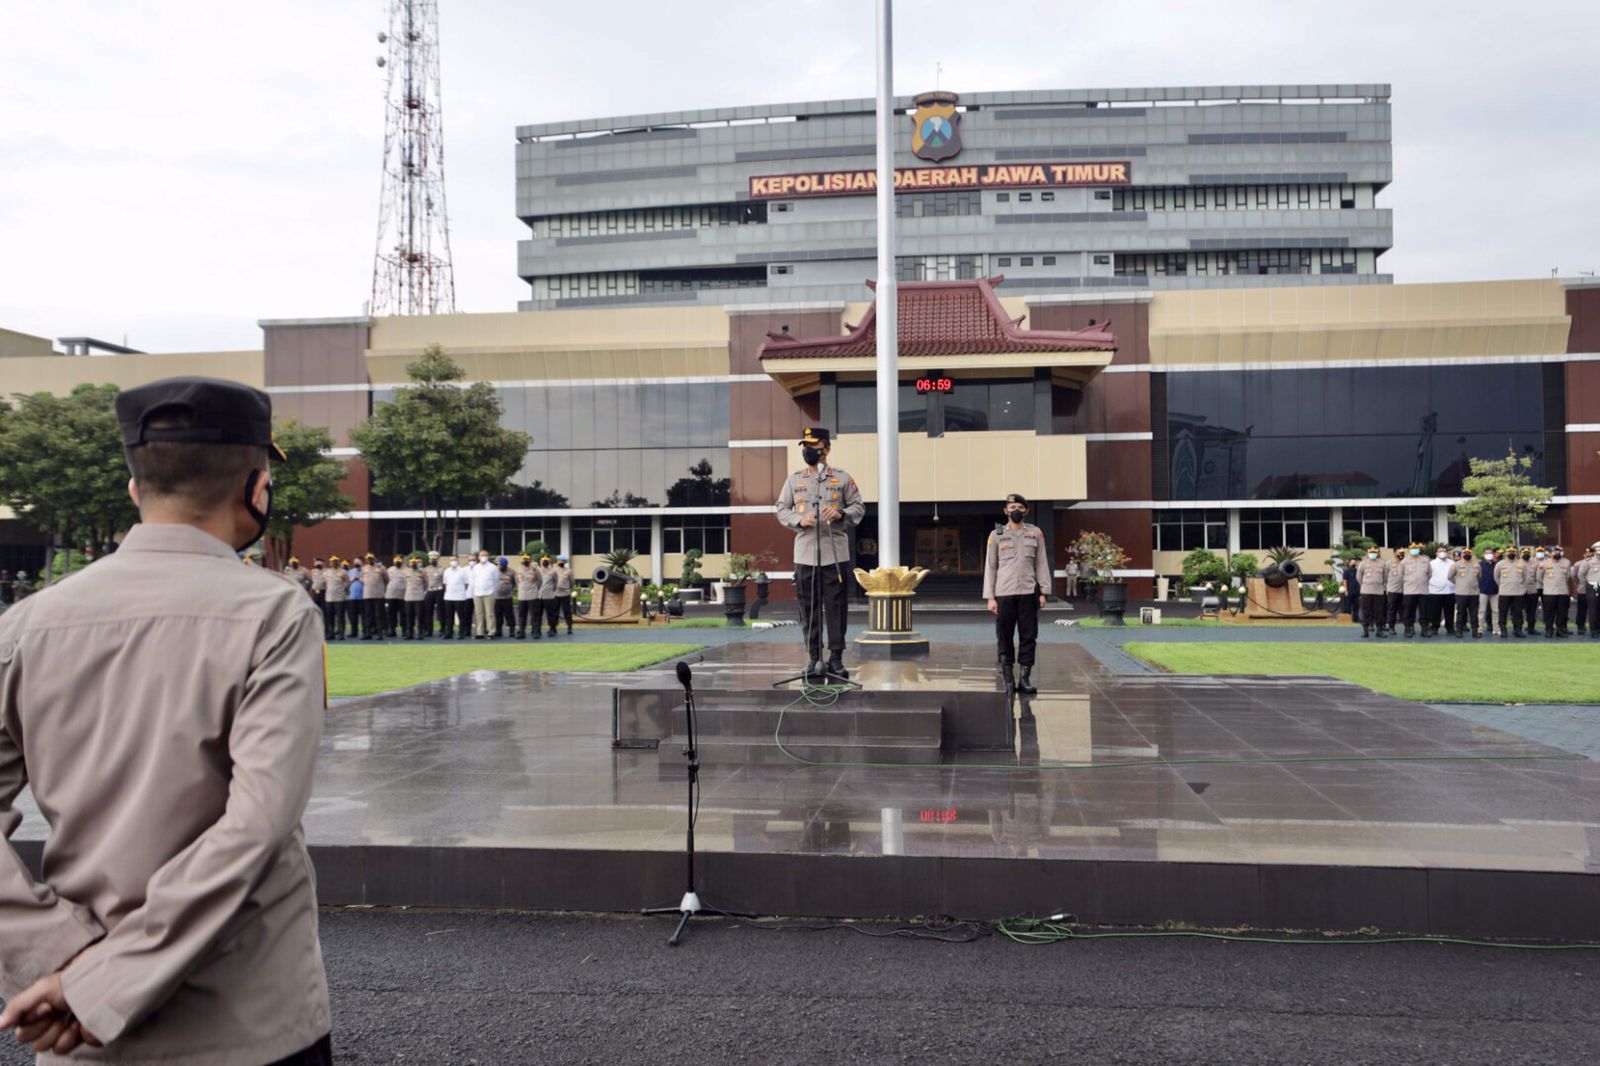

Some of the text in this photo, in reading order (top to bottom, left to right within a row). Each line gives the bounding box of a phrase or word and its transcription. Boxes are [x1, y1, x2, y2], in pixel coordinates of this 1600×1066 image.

[980, 165, 1048, 185] JAWA
[1050, 164, 1129, 185] TIMUR
[916, 379, 951, 391] 06:59
